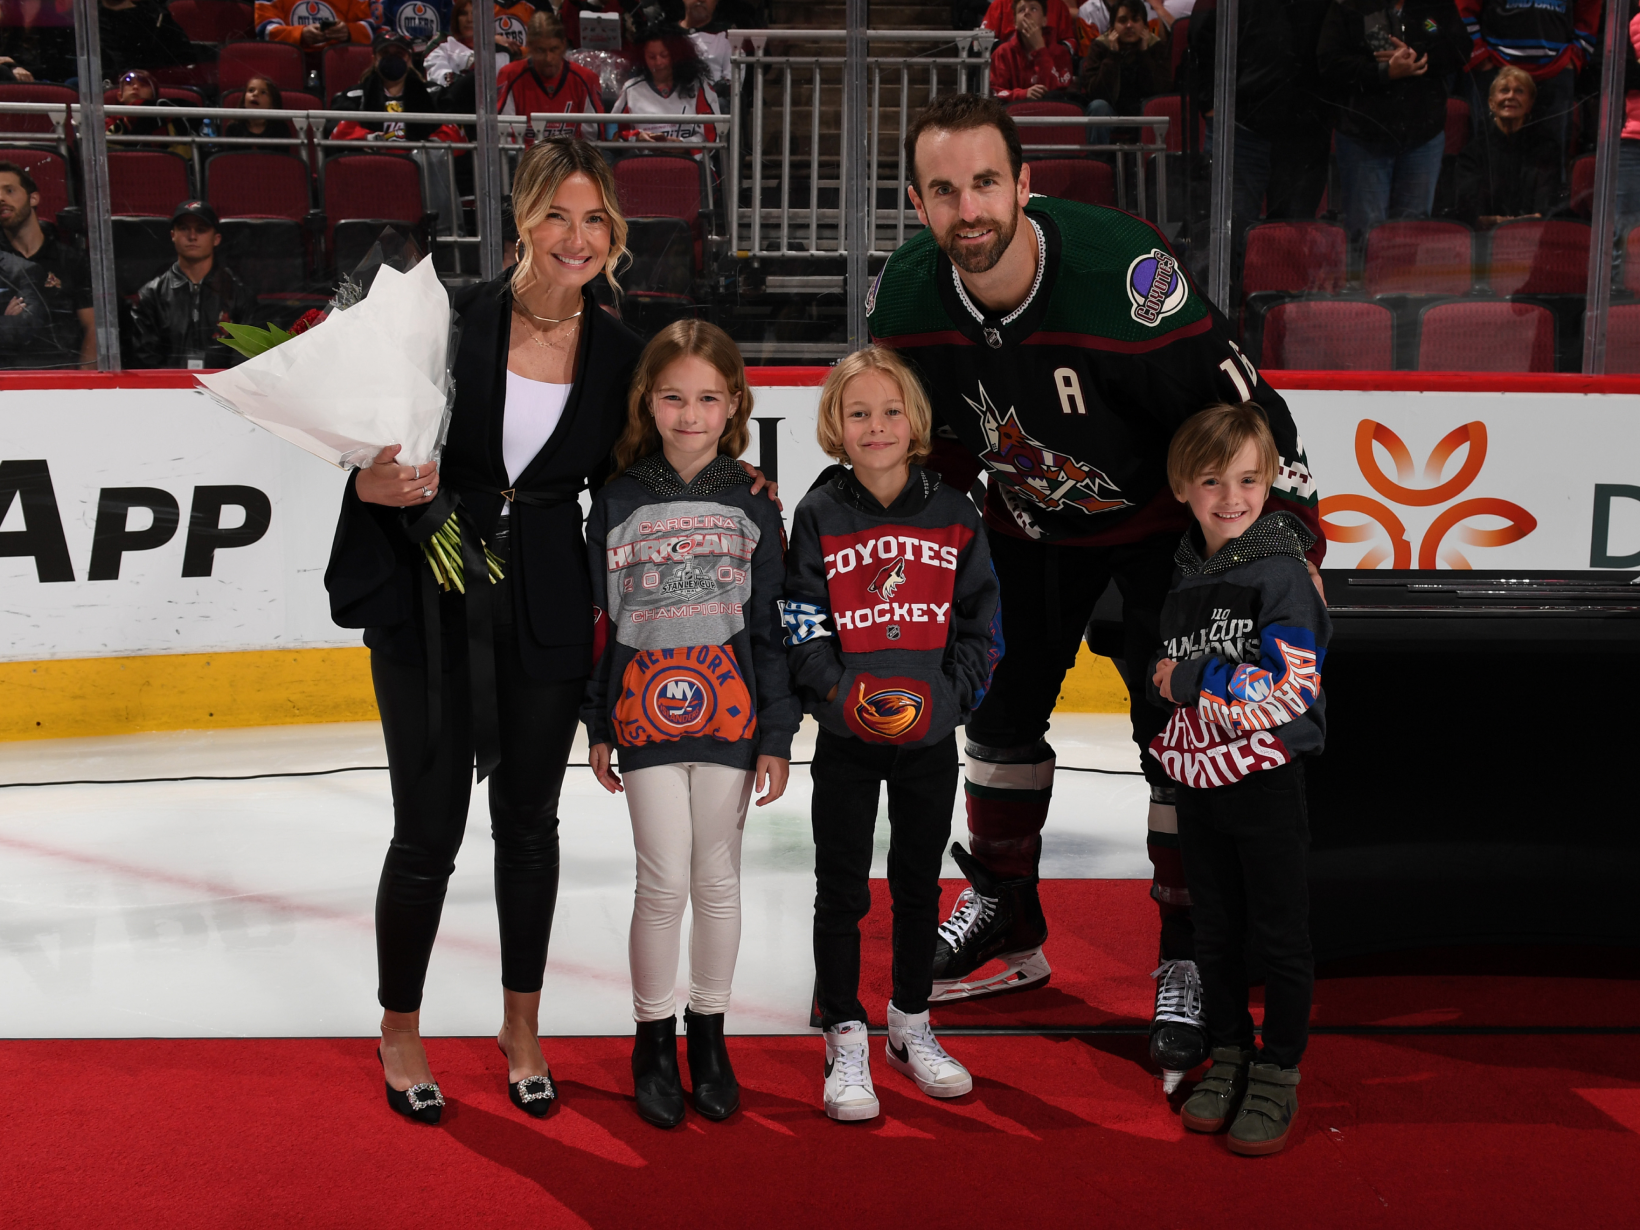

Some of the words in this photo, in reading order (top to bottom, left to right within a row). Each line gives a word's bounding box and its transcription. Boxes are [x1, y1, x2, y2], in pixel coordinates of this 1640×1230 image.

[1136, 251, 1174, 323] COYOTES
[1054, 366, 1088, 415] A
[0, 459, 272, 583] APP
[638, 515, 738, 534] CAROLINA
[607, 533, 758, 571] HURRCANES
[823, 535, 958, 581] COYOTES
[661, 580, 699, 594] STANLEY
[699, 580, 716, 590] CUP
[631, 602, 743, 623] CHAMPIONS
[834, 602, 950, 631] HOCKEY
[1209, 618, 1253, 641] CUP
[635, 647, 675, 674] NEW
[685, 645, 736, 687] YORK
